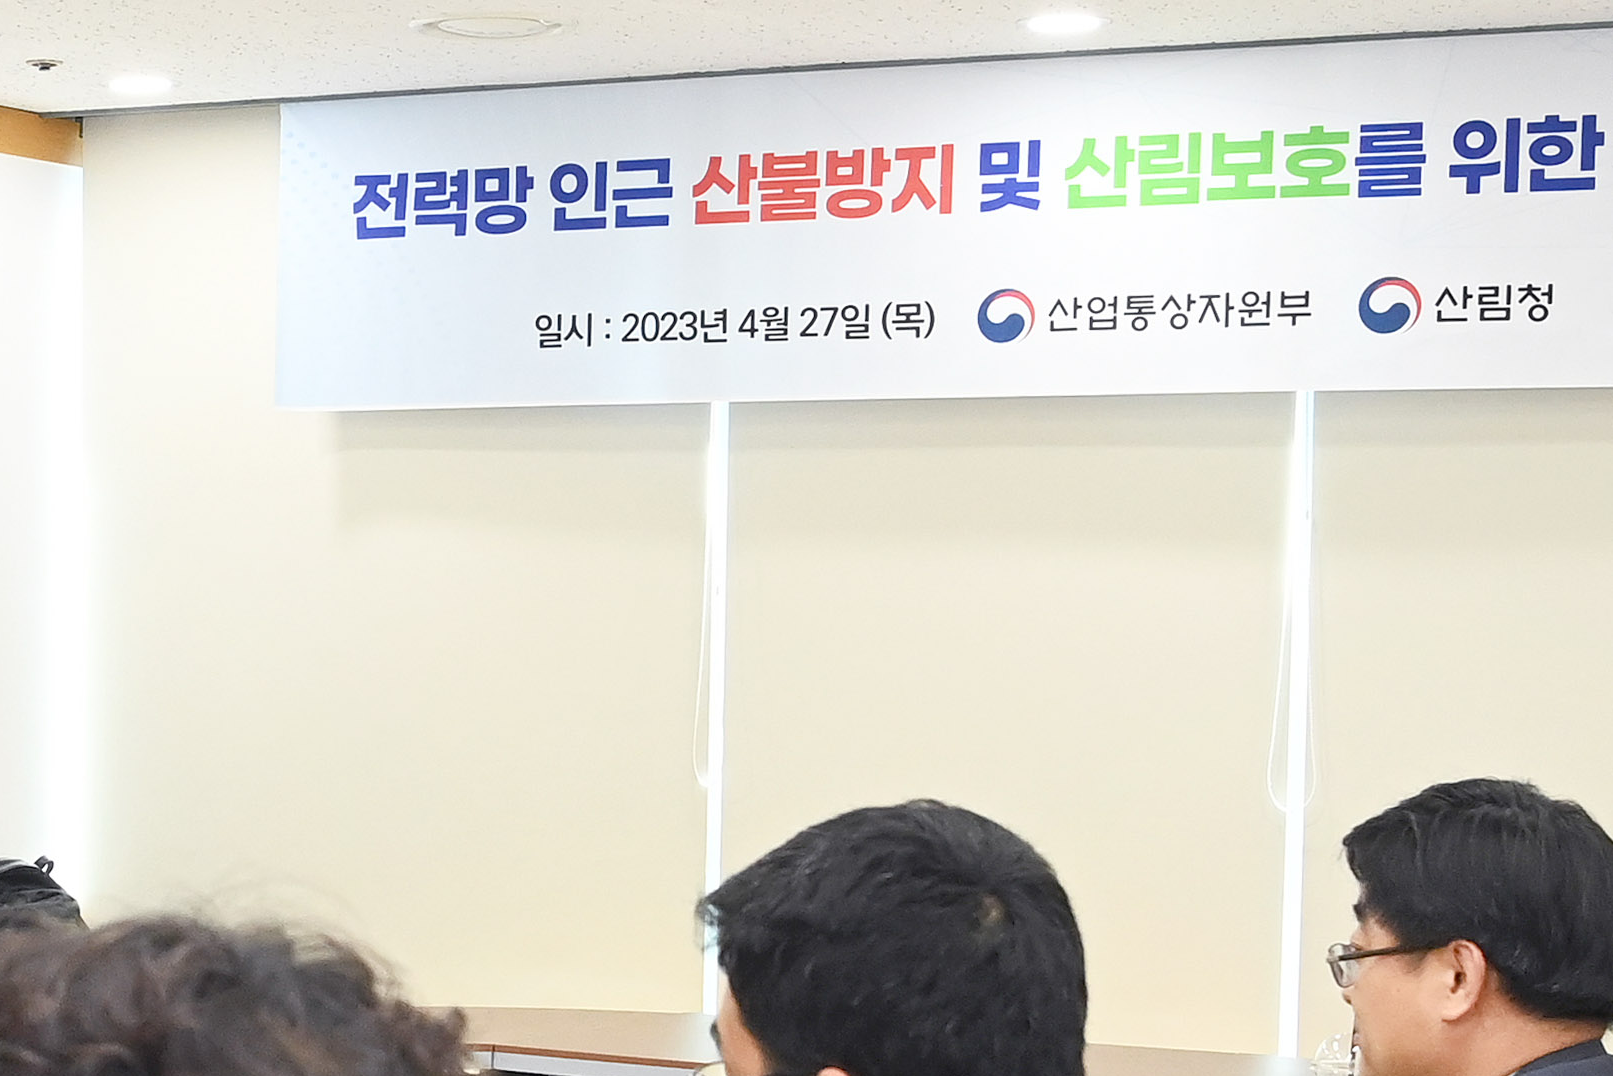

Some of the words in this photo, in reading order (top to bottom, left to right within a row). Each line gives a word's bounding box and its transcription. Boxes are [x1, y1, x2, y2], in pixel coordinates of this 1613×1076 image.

[352, 165, 535, 239] 전력망
[549, 157, 674, 232] 인근
[691, 143, 955, 225] 산불방지
[979, 139, 1042, 212] 및
[1063, 121, 1427, 210] 산림보호를
[1447, 113, 1606, 195] 위한
[534, 312, 594, 349] 일시
[620, 308, 730, 344] 2023년
[737, 305, 790, 342] 4월
[798, 302, 872, 340] 27일
[879, 300, 936, 340] (목)
[1047, 288, 1313, 333] 산업통상자원부
[1434, 282, 1555, 324] 산림청
